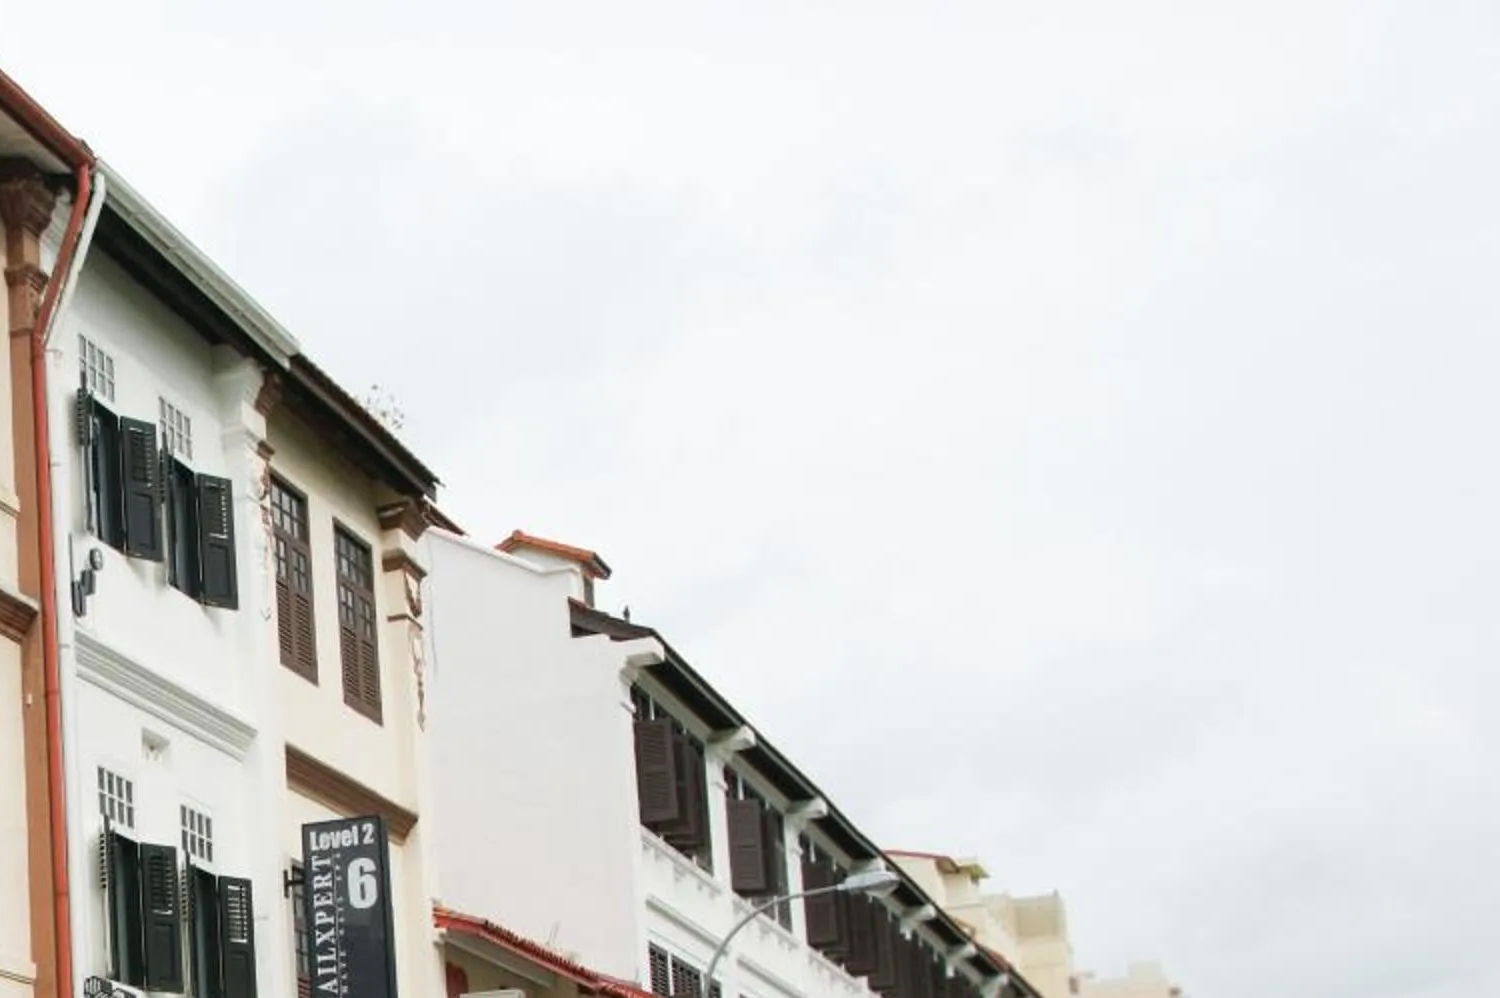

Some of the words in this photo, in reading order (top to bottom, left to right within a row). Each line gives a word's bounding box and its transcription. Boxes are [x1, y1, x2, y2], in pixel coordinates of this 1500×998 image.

[309, 826, 359, 851] Level
[363, 823, 375, 845] 2
[347, 857, 378, 909] 6
